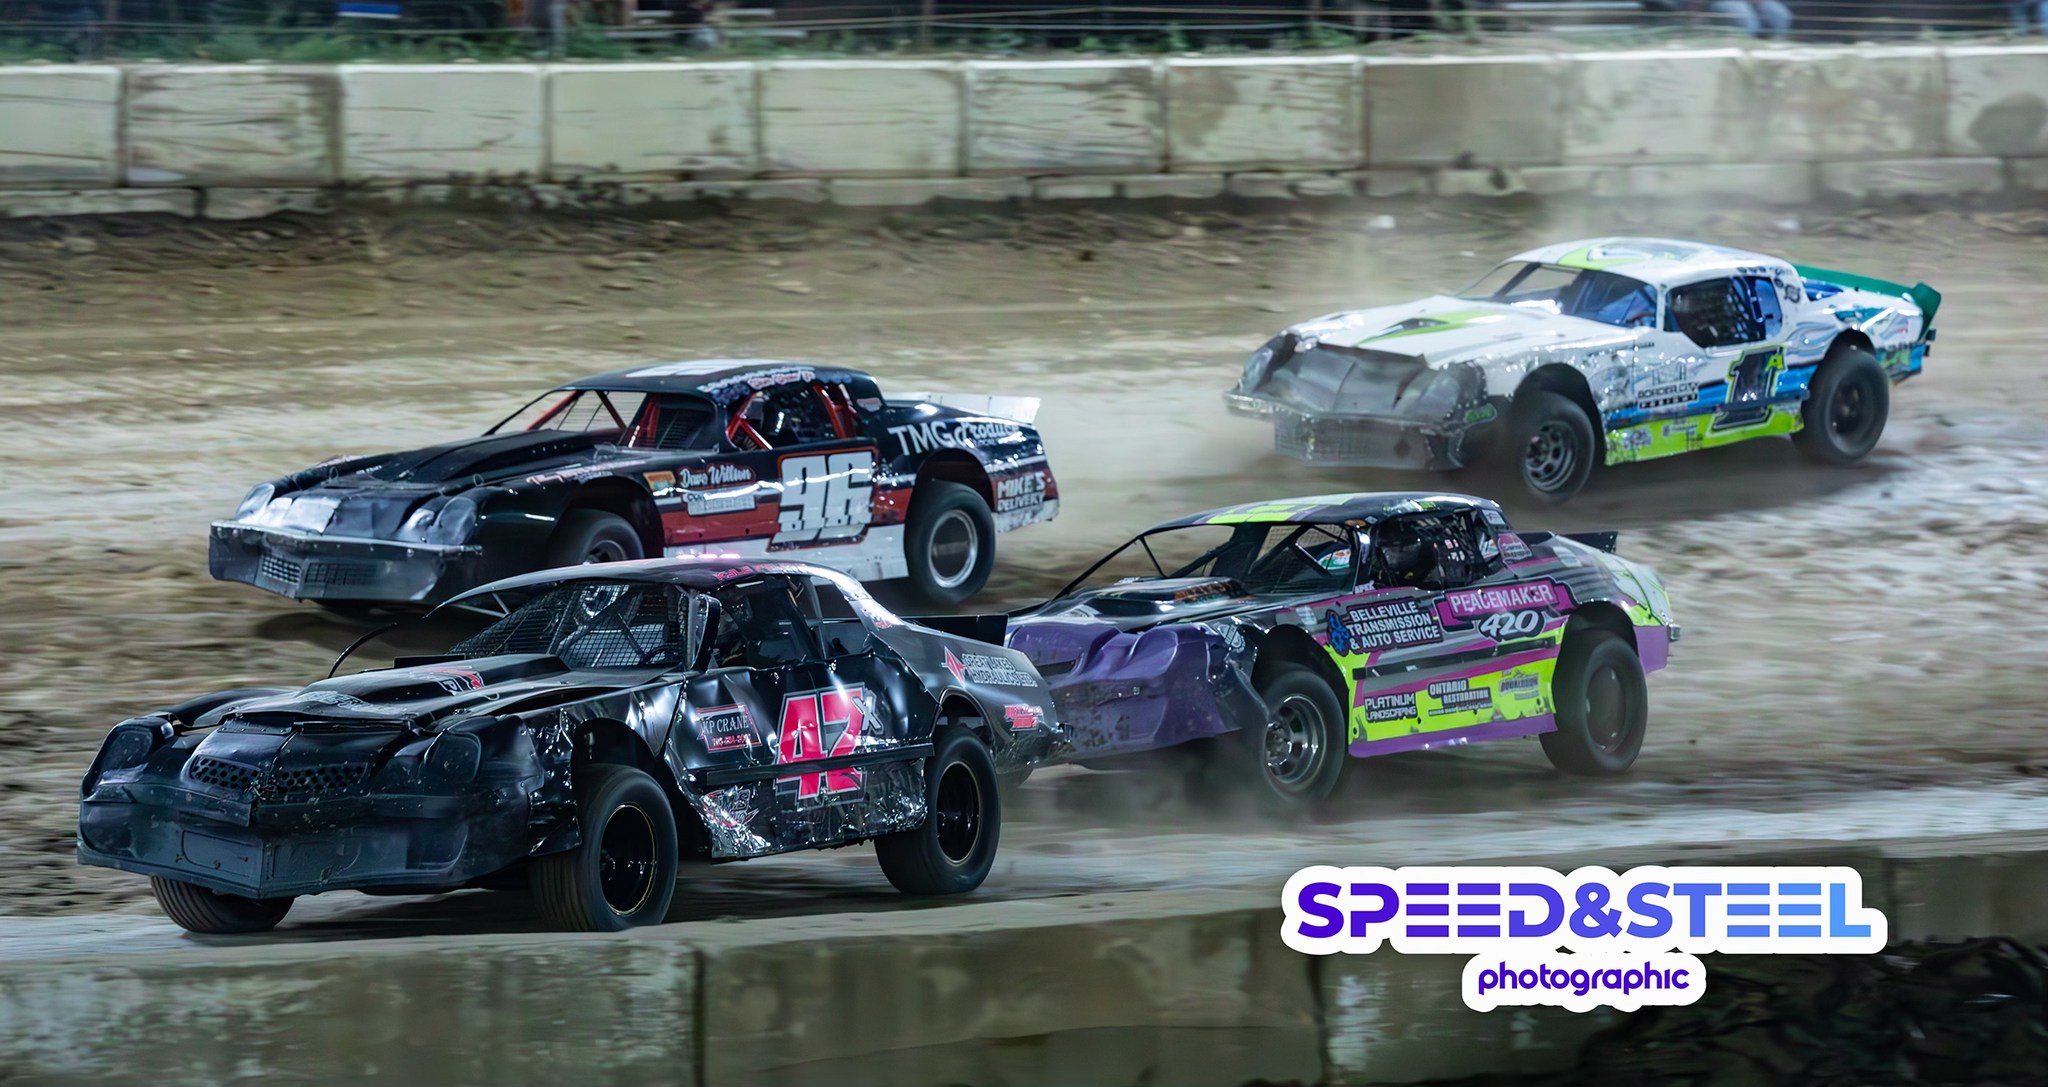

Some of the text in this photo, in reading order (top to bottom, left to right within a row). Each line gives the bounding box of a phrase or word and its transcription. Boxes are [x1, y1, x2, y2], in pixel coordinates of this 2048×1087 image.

[887, 421, 950, 456] TMG
[997, 471, 1045, 496] MIKE'S
[771, 451, 873, 544] 96
[997, 493, 1044, 511] DELIVERY
[1450, 584, 1553, 613] PEACEMAKER
[1350, 601, 1418, 623] BELLEVILLE
[1480, 610, 1539, 637] 420
[1346, 612, 1432, 636] TRANSMISSION
[1349, 625, 1440, 650] & AUTO SERVICE
[1429, 679, 1467, 696] ONTARIO
[1443, 689, 1490, 704] RESTORATION
[1364, 693, 1415, 710] PLATINUM
[1366, 705, 1417, 721] LANDSCAPING
[716, 715, 750, 733] CRANE
